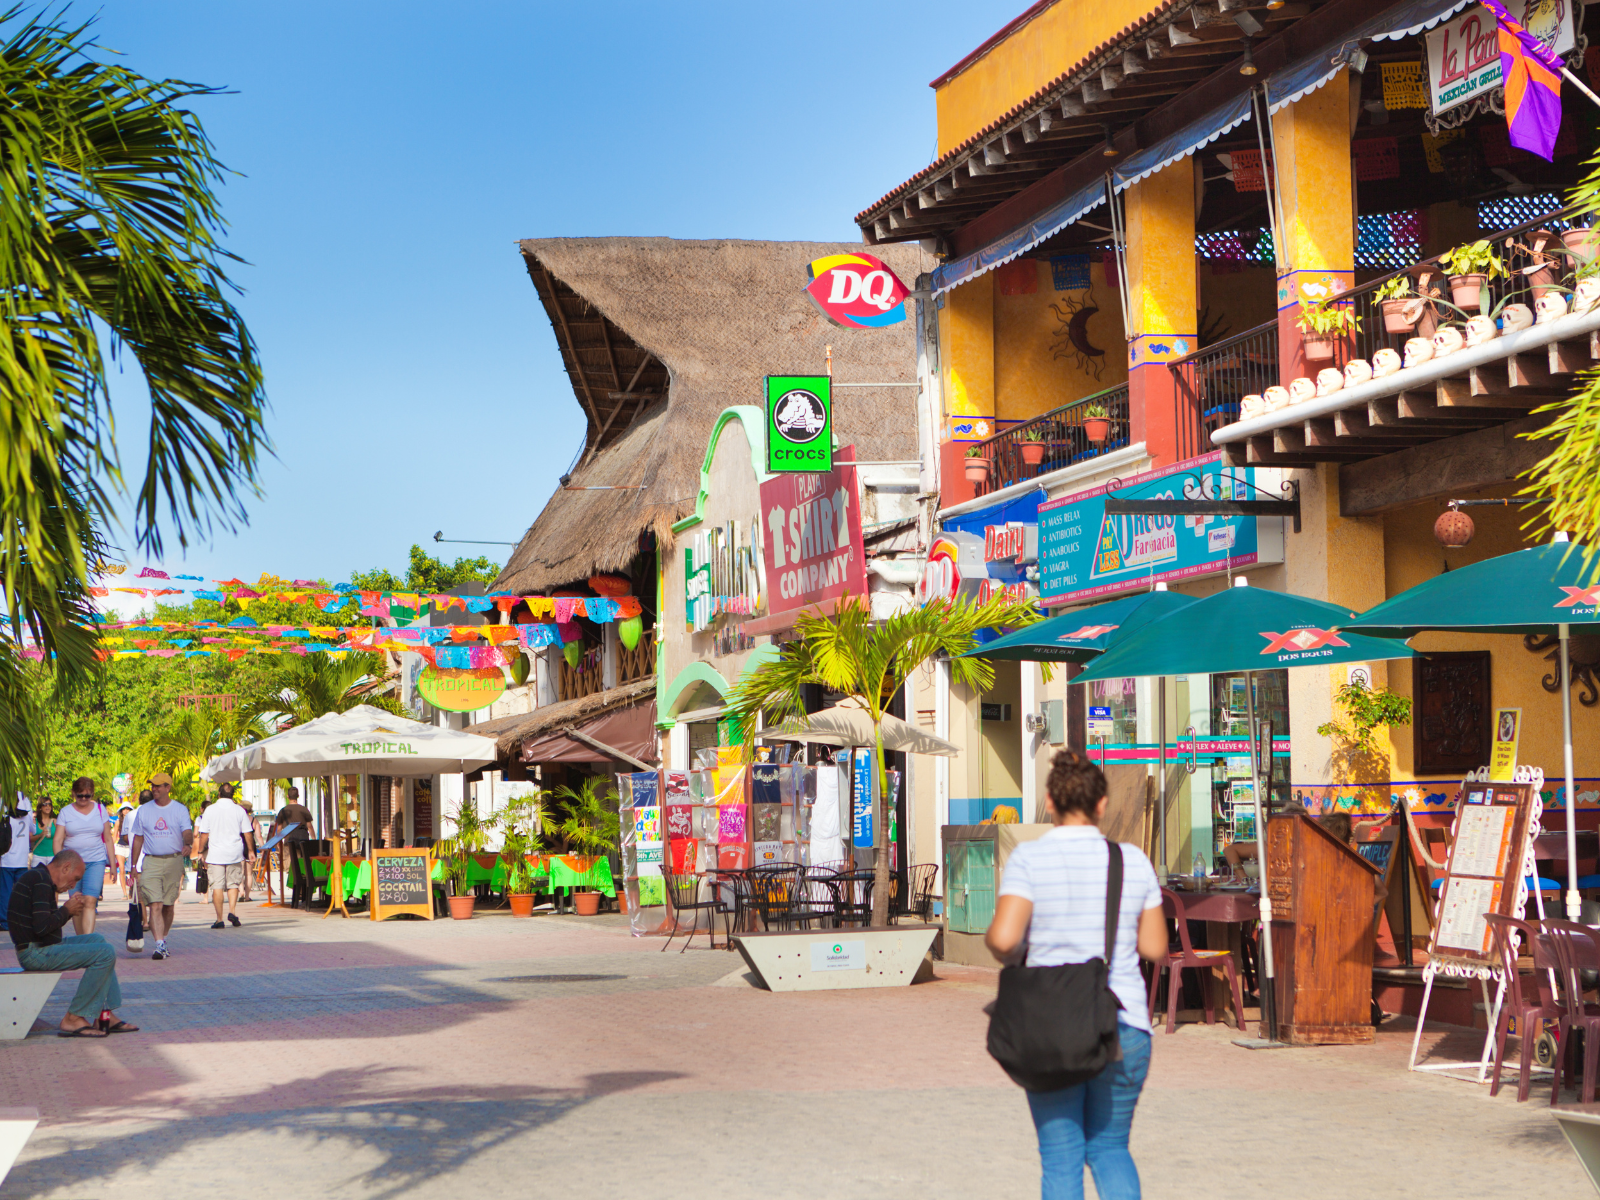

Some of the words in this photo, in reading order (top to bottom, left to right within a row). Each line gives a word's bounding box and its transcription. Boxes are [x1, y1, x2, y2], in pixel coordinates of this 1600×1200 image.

[1439, 28, 1464, 88] La
[1438, 77, 1477, 107] MEXICAN
[774, 447, 826, 461] crocs
[798, 473, 822, 501] PLAYA
[1048, 514, 1063, 527] MASS
[1063, 509, 1081, 524] RELAX
[1048, 525, 1082, 543] ANTIBIOTICS
[1102, 533, 1114, 550] PAY
[984, 523, 1024, 565] Dairy
[1049, 541, 1080, 558] ANABOLICS
[1049, 560, 1069, 574] VIAGRA
[1098, 549, 1120, 573] LESS
[780, 552, 850, 600] COMPANY
[1050, 577, 1061, 589] DIET
[1063, 574, 1078, 587] PILLS
[1571, 607, 1595, 615] DOS
[1278, 652, 1300, 662] DOS
[1301, 649, 1333, 659] EQUIS
[422, 677, 503, 691] TROPICAL
[340, 741, 418, 755] TROPICAL
[1217, 742, 1237, 750] ALEVE
[854, 768, 864, 838] infinitum
[16, 821, 26, 838] 2
[377, 856, 424, 867] CERVEZA
[636, 852, 648, 860] 5th
[648, 851, 663, 859] AVE
[378, 882, 426, 892] COCKTAIL
